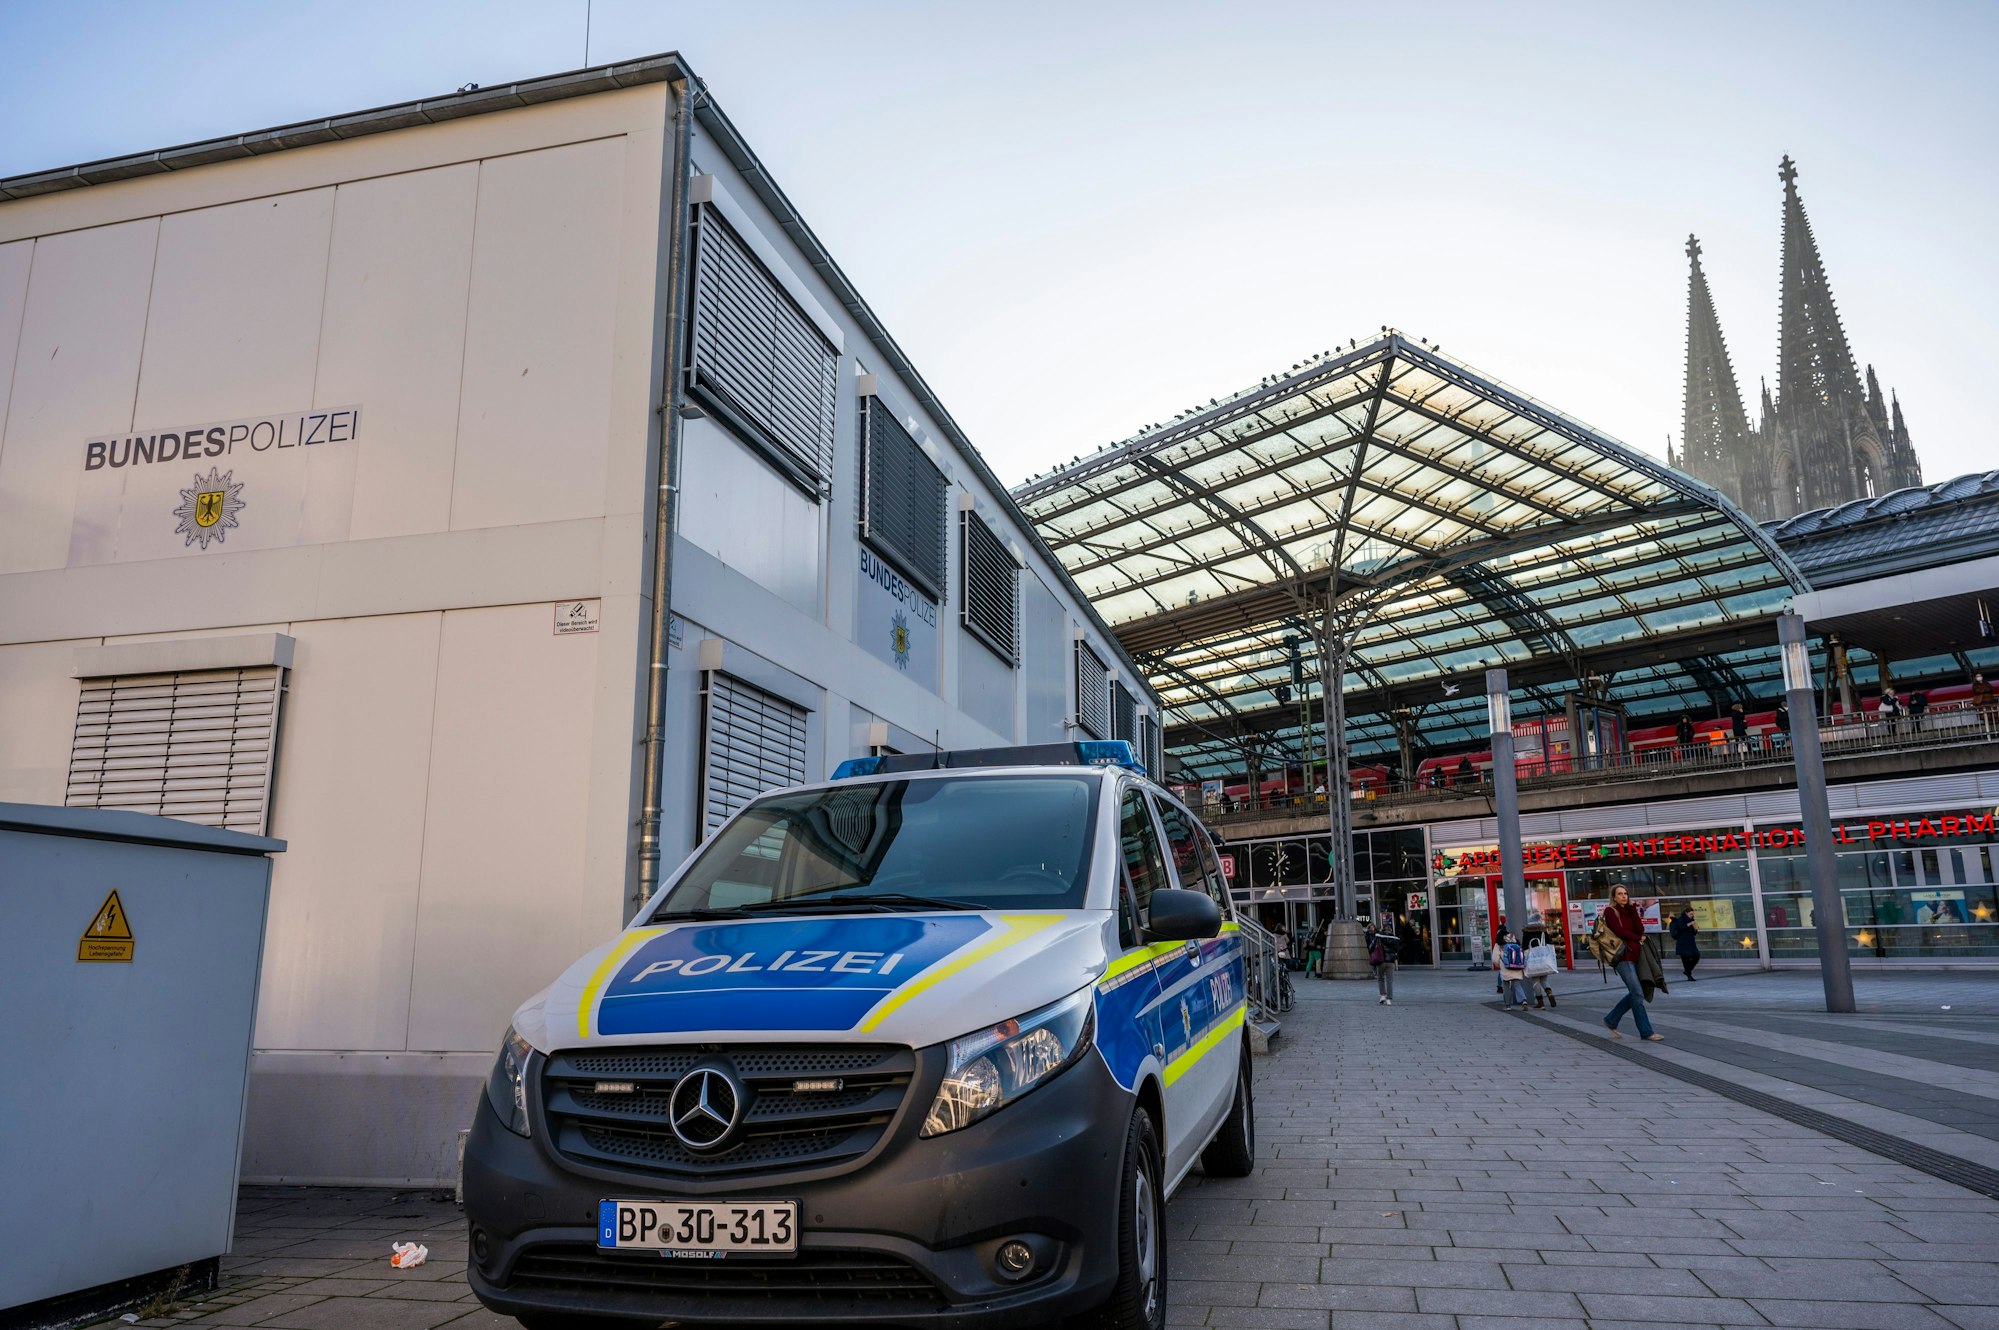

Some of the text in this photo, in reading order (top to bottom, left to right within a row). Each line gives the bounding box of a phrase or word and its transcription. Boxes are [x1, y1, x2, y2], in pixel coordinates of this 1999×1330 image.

[84, 410, 358, 471] BUNDESPOLIZEI
[860, 548, 937, 629] BUNDESPOLIZEI
[1458, 843, 1579, 868] APOHEKE
[1618, 824, 1855, 858] INTERNATIONL
[88, 944, 127, 952] Hochspannung
[629, 950, 904, 983] POLIZEI
[604, 1207, 792, 1244] D BP 30-313
[672, 1250, 715, 1258] MOSOLF
